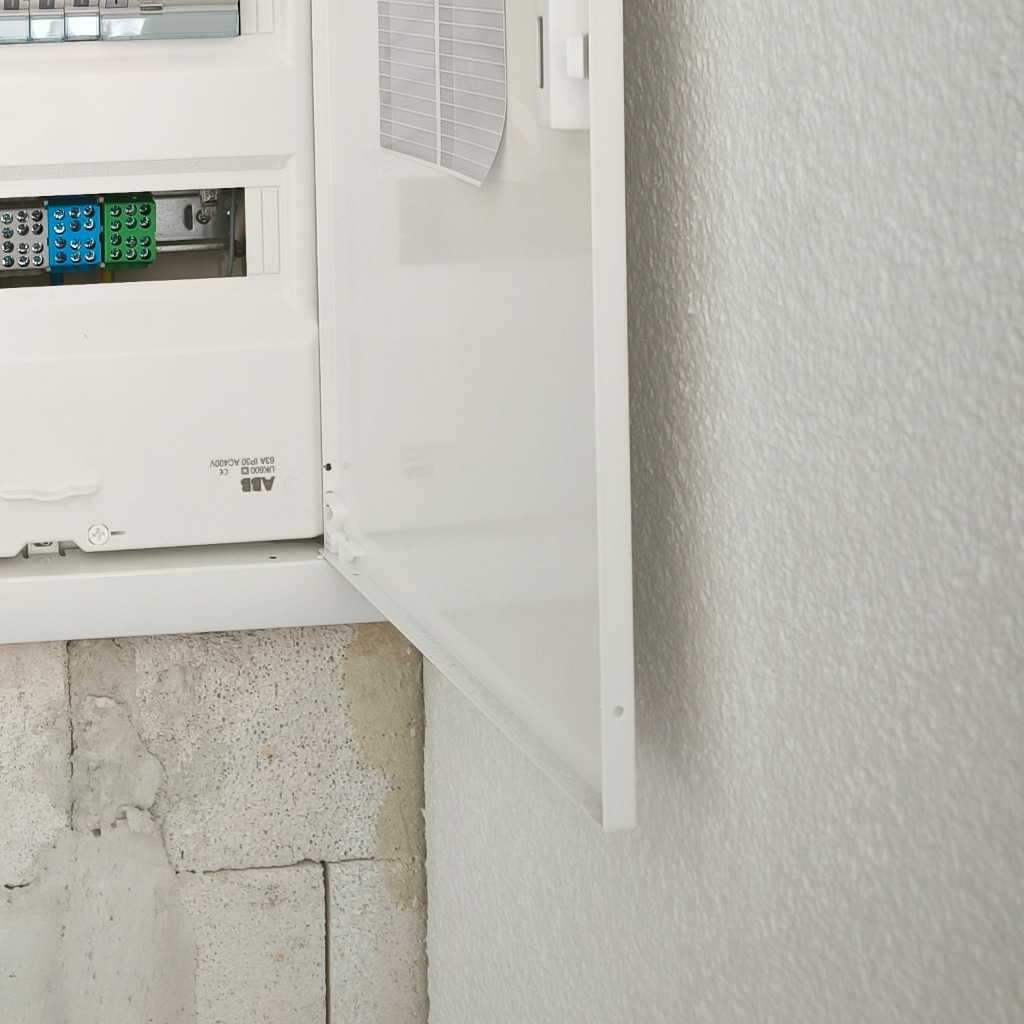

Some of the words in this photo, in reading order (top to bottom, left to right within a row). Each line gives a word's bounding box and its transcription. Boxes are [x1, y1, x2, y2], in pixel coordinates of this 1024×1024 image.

[210, 458, 240, 468] AC400V
[242, 457, 258, 466] IP30
[260, 456, 274, 465] 63A
[240, 476, 276, 492] ABB
